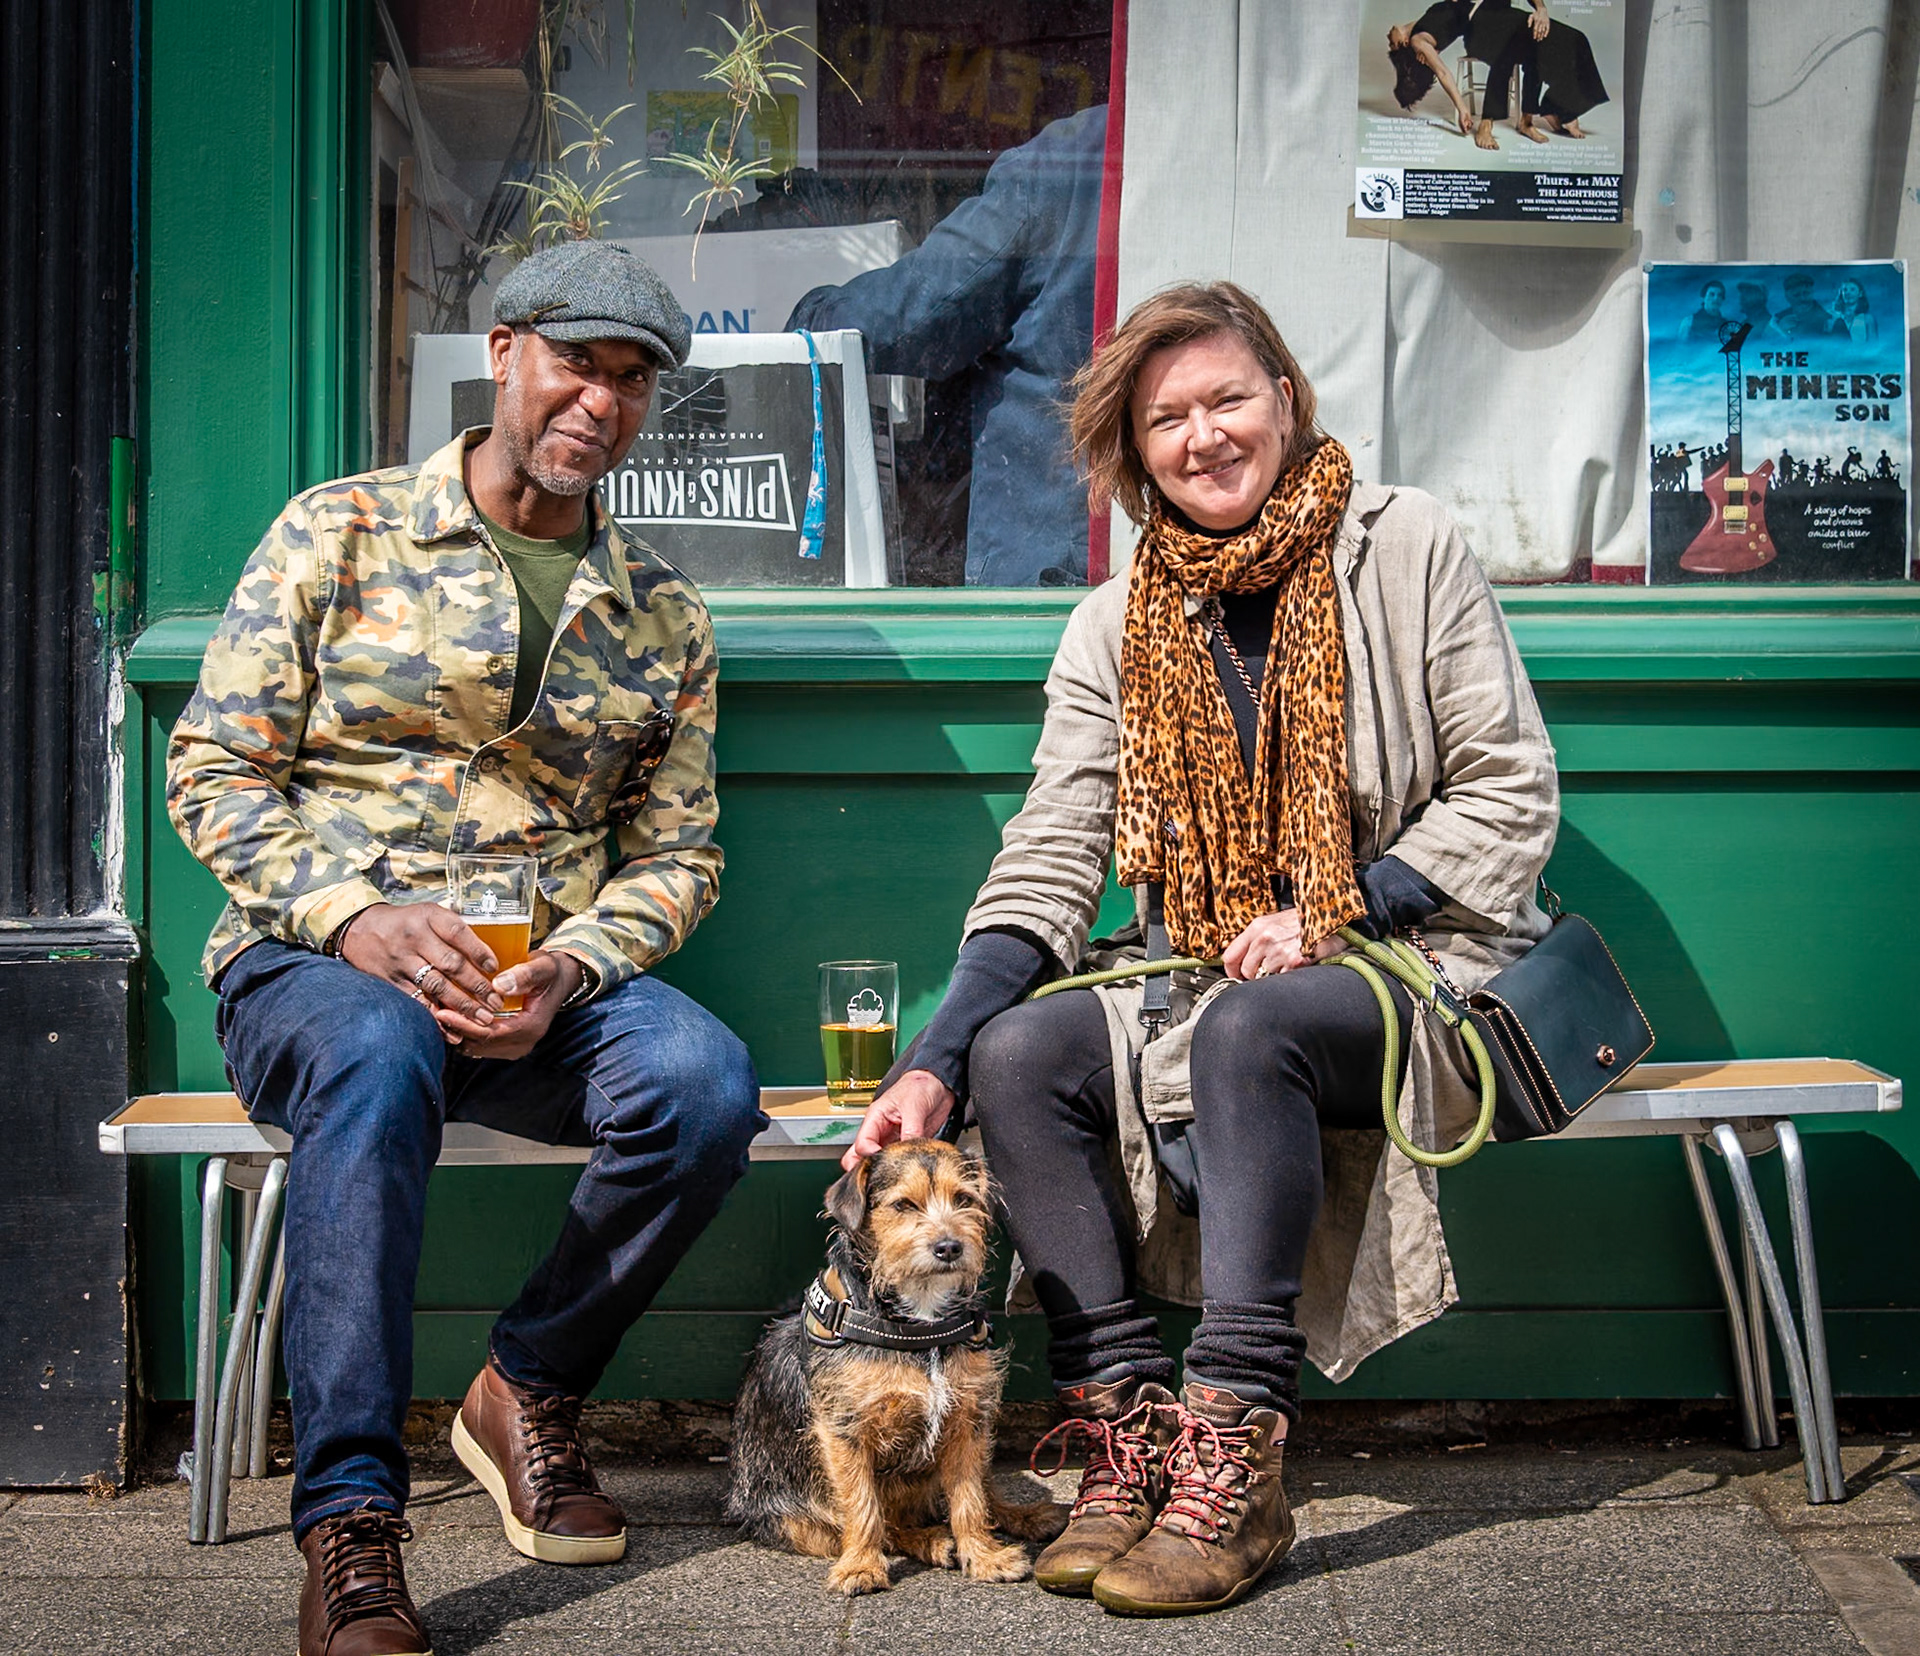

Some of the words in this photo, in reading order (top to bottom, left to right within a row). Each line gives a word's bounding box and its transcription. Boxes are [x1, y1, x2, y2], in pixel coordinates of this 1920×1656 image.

[1534, 174, 1573, 186] Thurs.
[1576, 177, 1590, 187] 1st
[1591, 176, 1620, 188] MAY
[1538, 188, 1558, 198] THE
[1559, 189, 1619, 199] LIGHTHOUSE
[1760, 351, 1809, 368] THE
[1746, 372, 1902, 400] MINER'S
[1835, 404, 1890, 421] SON
[638, 432, 764, 440] PINSANDKNUCKL
[627, 457, 723, 465] MERCHAN
[598, 469, 685, 516] KNUC
[700, 466, 777, 520] PINS
[1803, 503, 1812, 516] A
[1813, 505, 1837, 517] story
[1838, 504, 1848, 516] of
[1848, 505, 1872, 517] hopes
[1813, 516, 1831, 526] and
[1832, 517, 1863, 527] dreams
[1807, 529, 1838, 538] amidst
[1822, 539, 1855, 551] conflict
